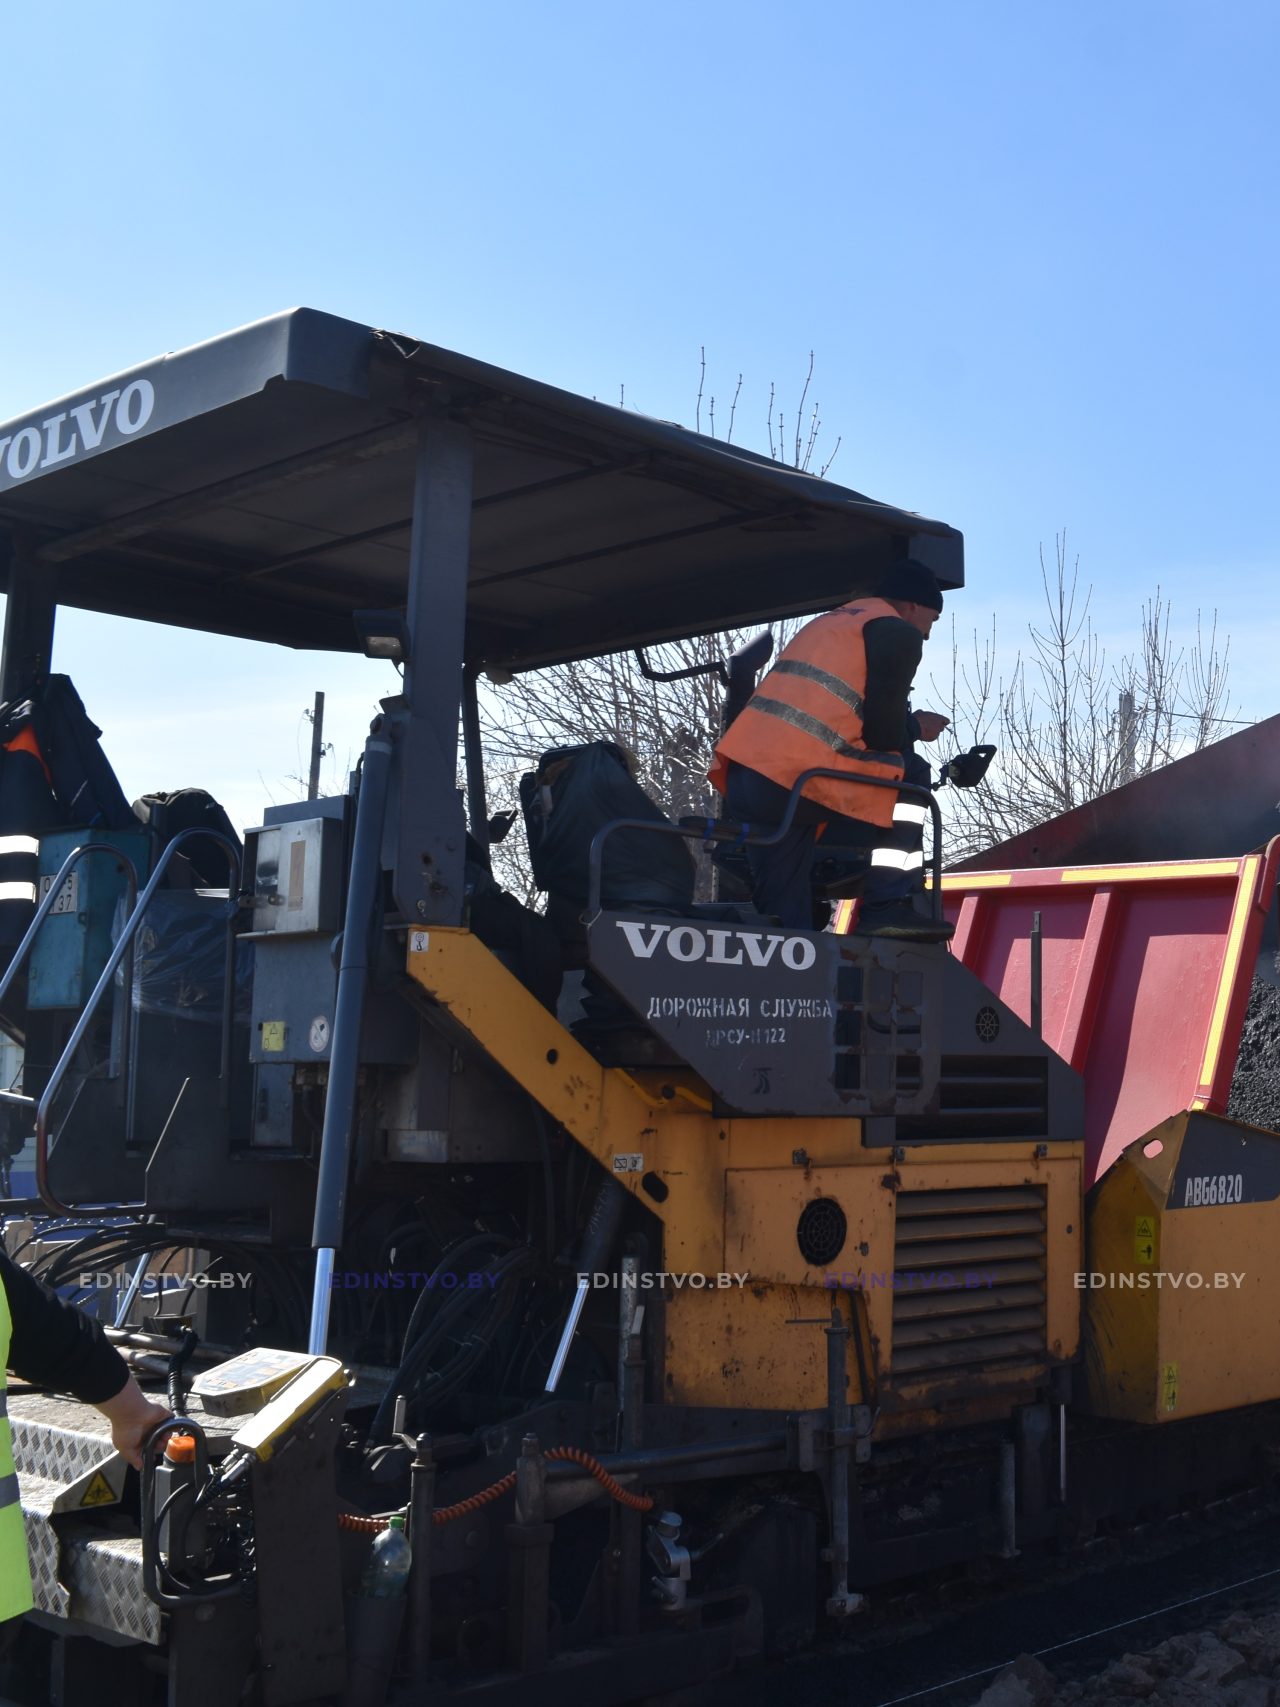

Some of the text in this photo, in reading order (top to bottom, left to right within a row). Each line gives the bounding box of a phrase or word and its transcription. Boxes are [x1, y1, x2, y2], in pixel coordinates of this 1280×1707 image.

[0, 379, 155, 479] OLVO
[616, 921, 816, 971] VOLVO
[647, 997, 833, 1019] ДОРОЖНАЯ СЛУЖБА
[1184, 1174, 1243, 1207] ABG6820
